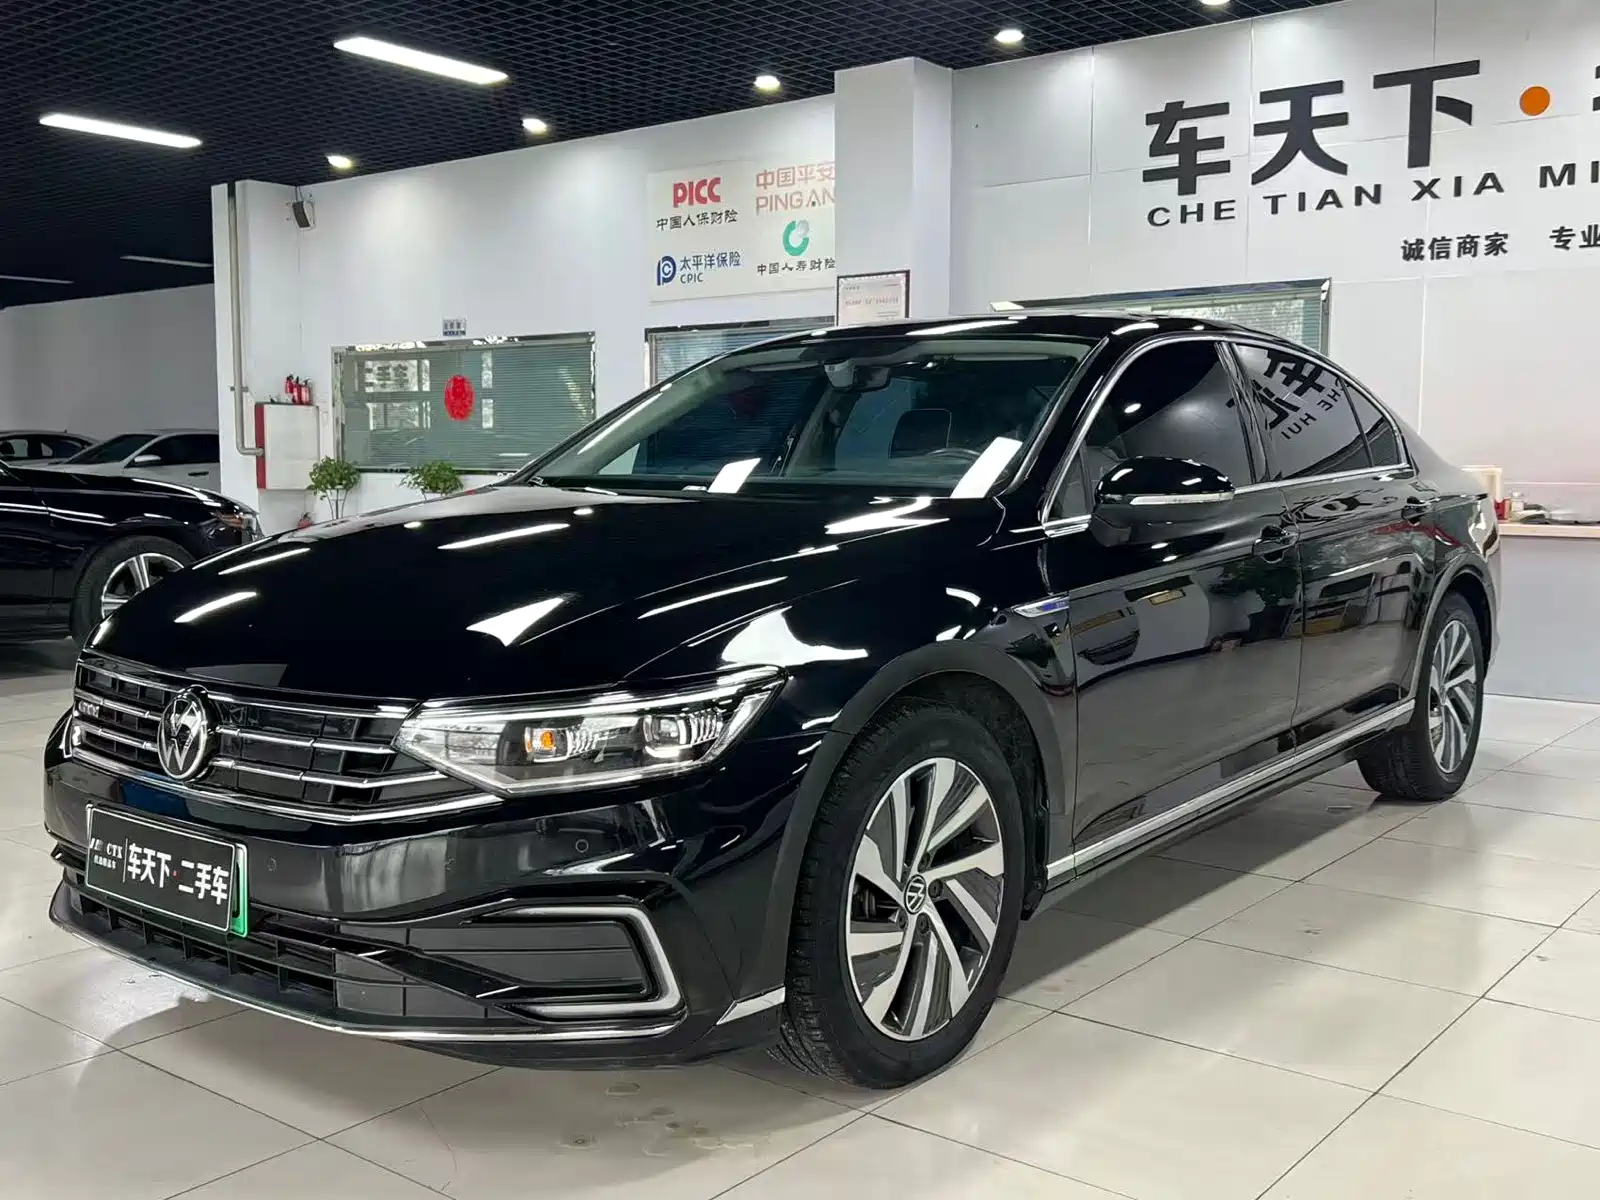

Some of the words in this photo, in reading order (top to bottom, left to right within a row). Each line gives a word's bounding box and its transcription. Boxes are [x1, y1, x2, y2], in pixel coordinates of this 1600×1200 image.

[756, 164, 835, 190] 中国平安
[672, 176, 722, 209] PICC
[1147, 199, 1236, 227] CHE
[1263, 183, 1382, 216] TIAN
[1410, 171, 1505, 202] XIA
[655, 208, 739, 232] 中国人保财险
[1400, 231, 1509, 262] 诚信商家
[679, 250, 741, 272] 太平洋保险
[756, 256, 835, 276] 中国人寿财险
[679, 272, 704, 285] CPIC
